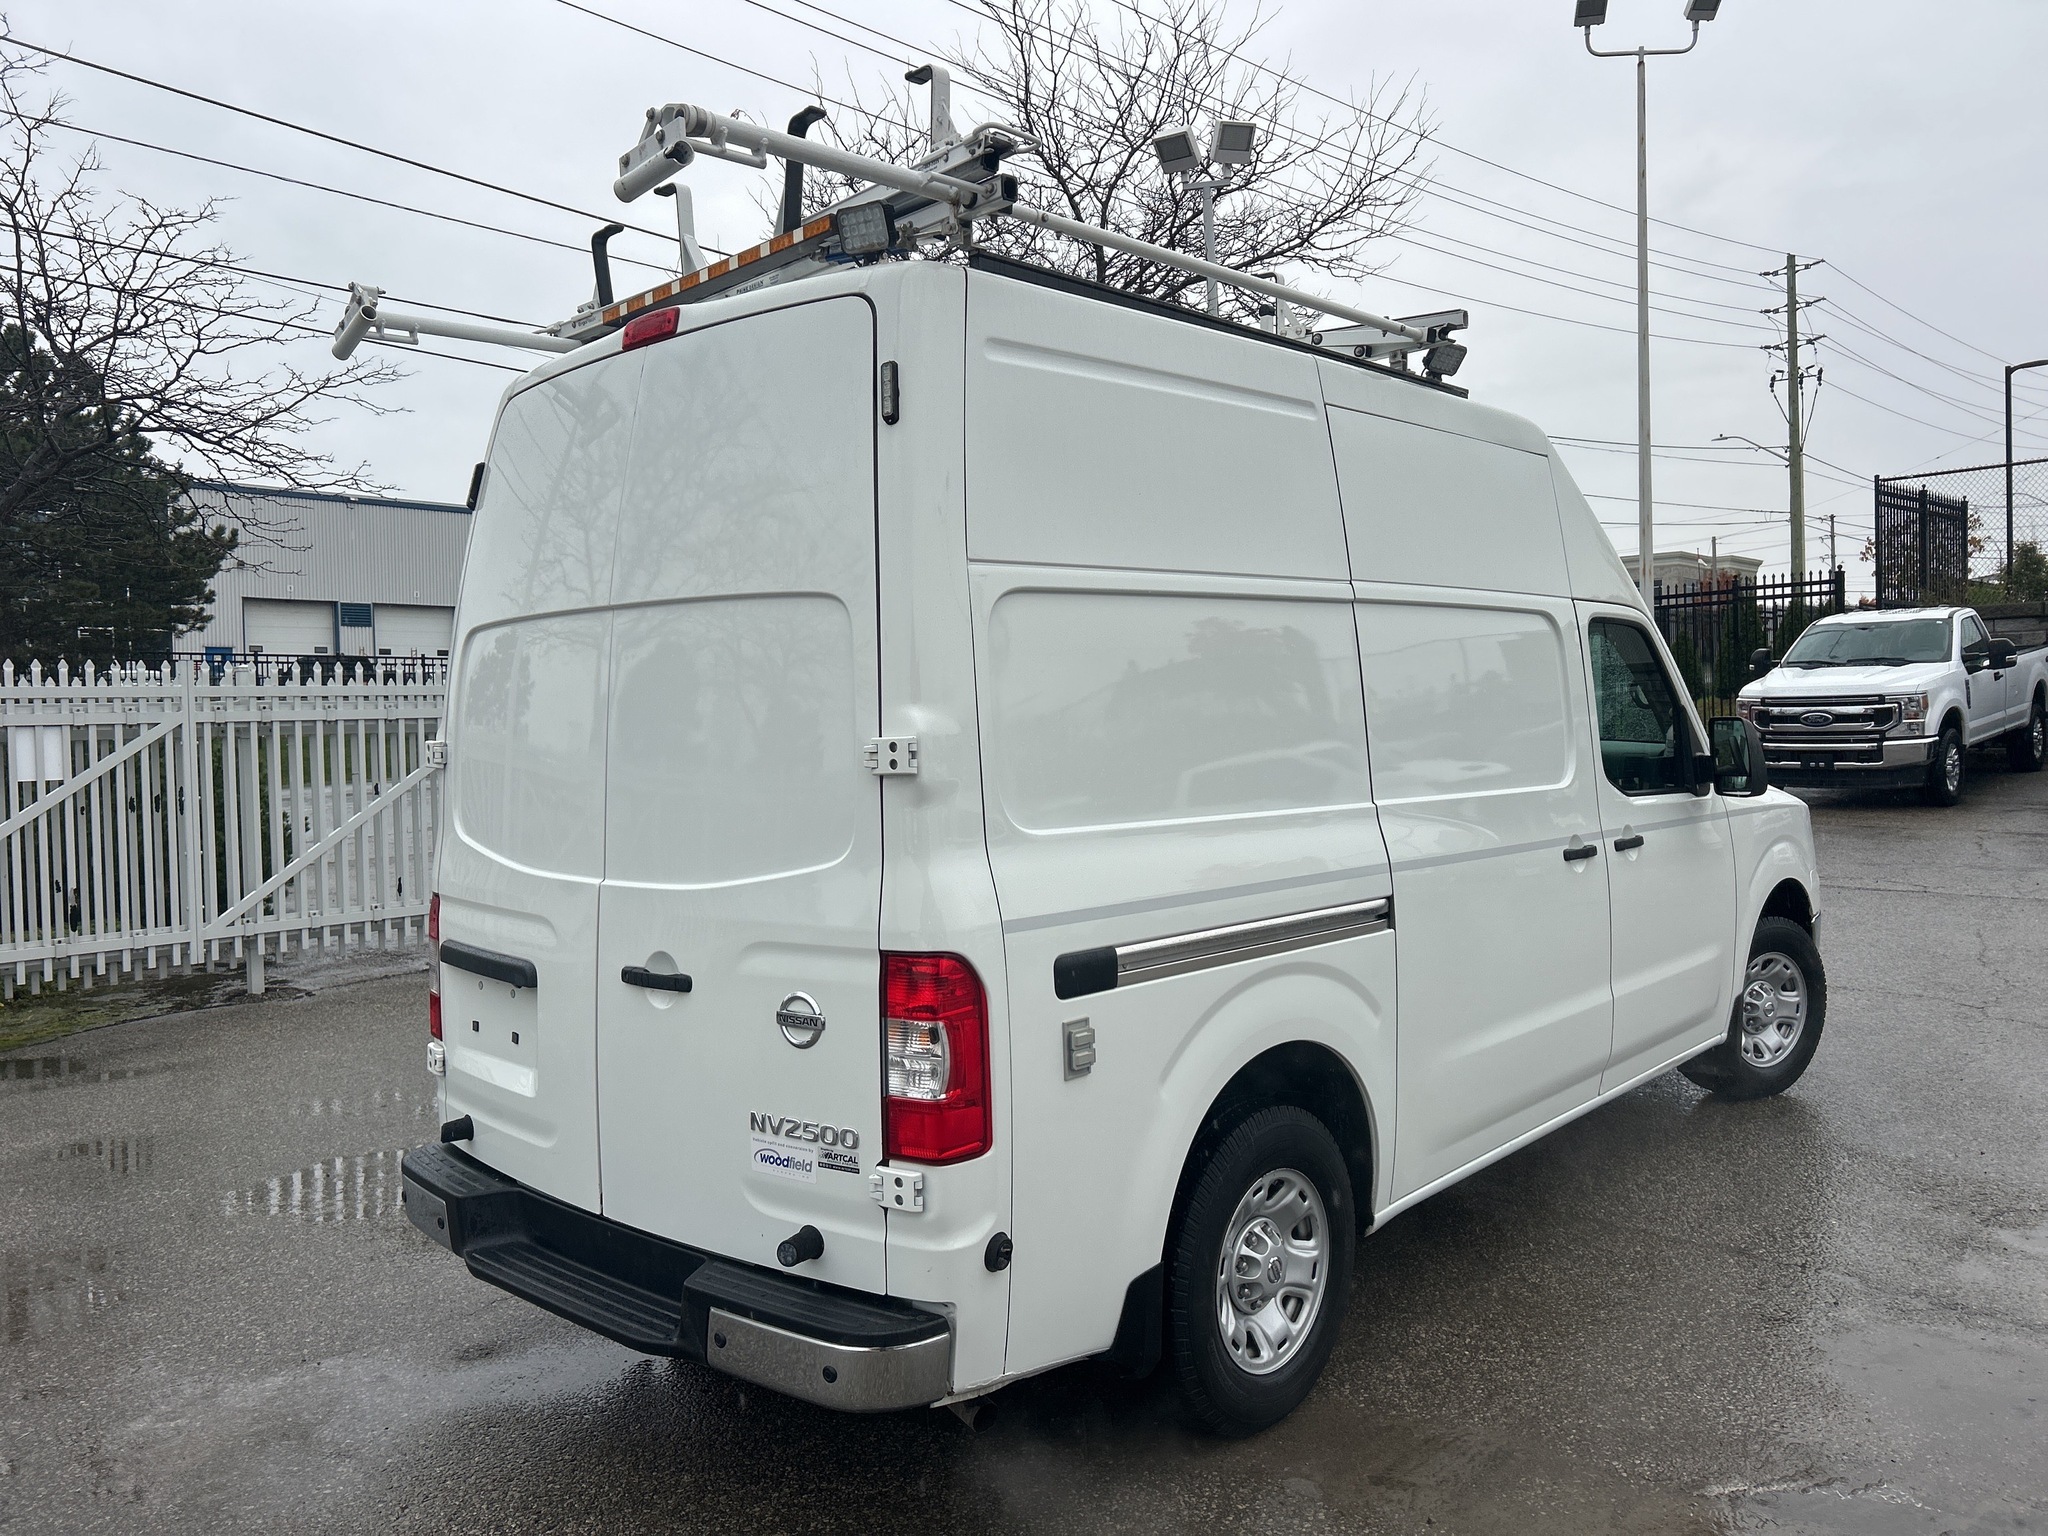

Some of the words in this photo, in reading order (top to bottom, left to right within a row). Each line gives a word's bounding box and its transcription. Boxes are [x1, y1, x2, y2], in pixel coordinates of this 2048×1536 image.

[779, 1014, 818, 1027] NISSAN
[750, 1110, 860, 1150] NV2500
[760, 1152, 813, 1173] woodfield
